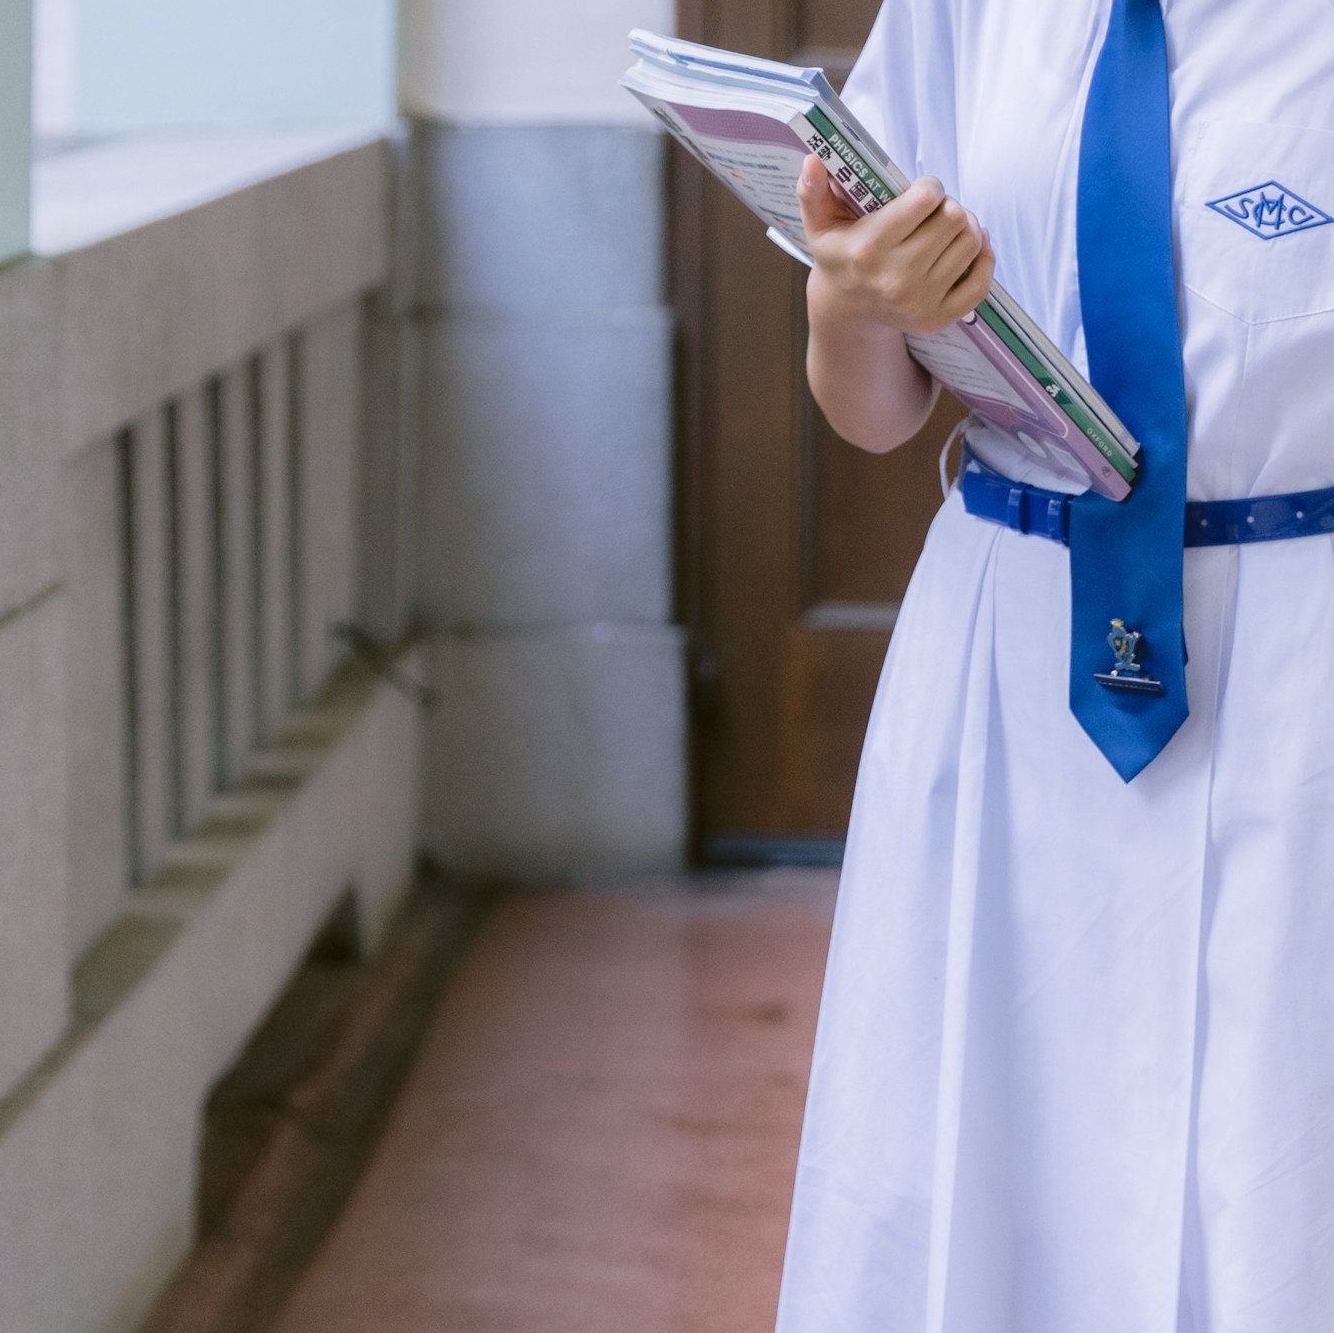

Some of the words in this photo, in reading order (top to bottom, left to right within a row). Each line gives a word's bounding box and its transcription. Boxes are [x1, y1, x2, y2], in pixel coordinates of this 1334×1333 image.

[828, 133, 868, 178] PHYSICS
[865, 177, 881, 192] AT
[1087, 427, 1113, 457] OXFORD
